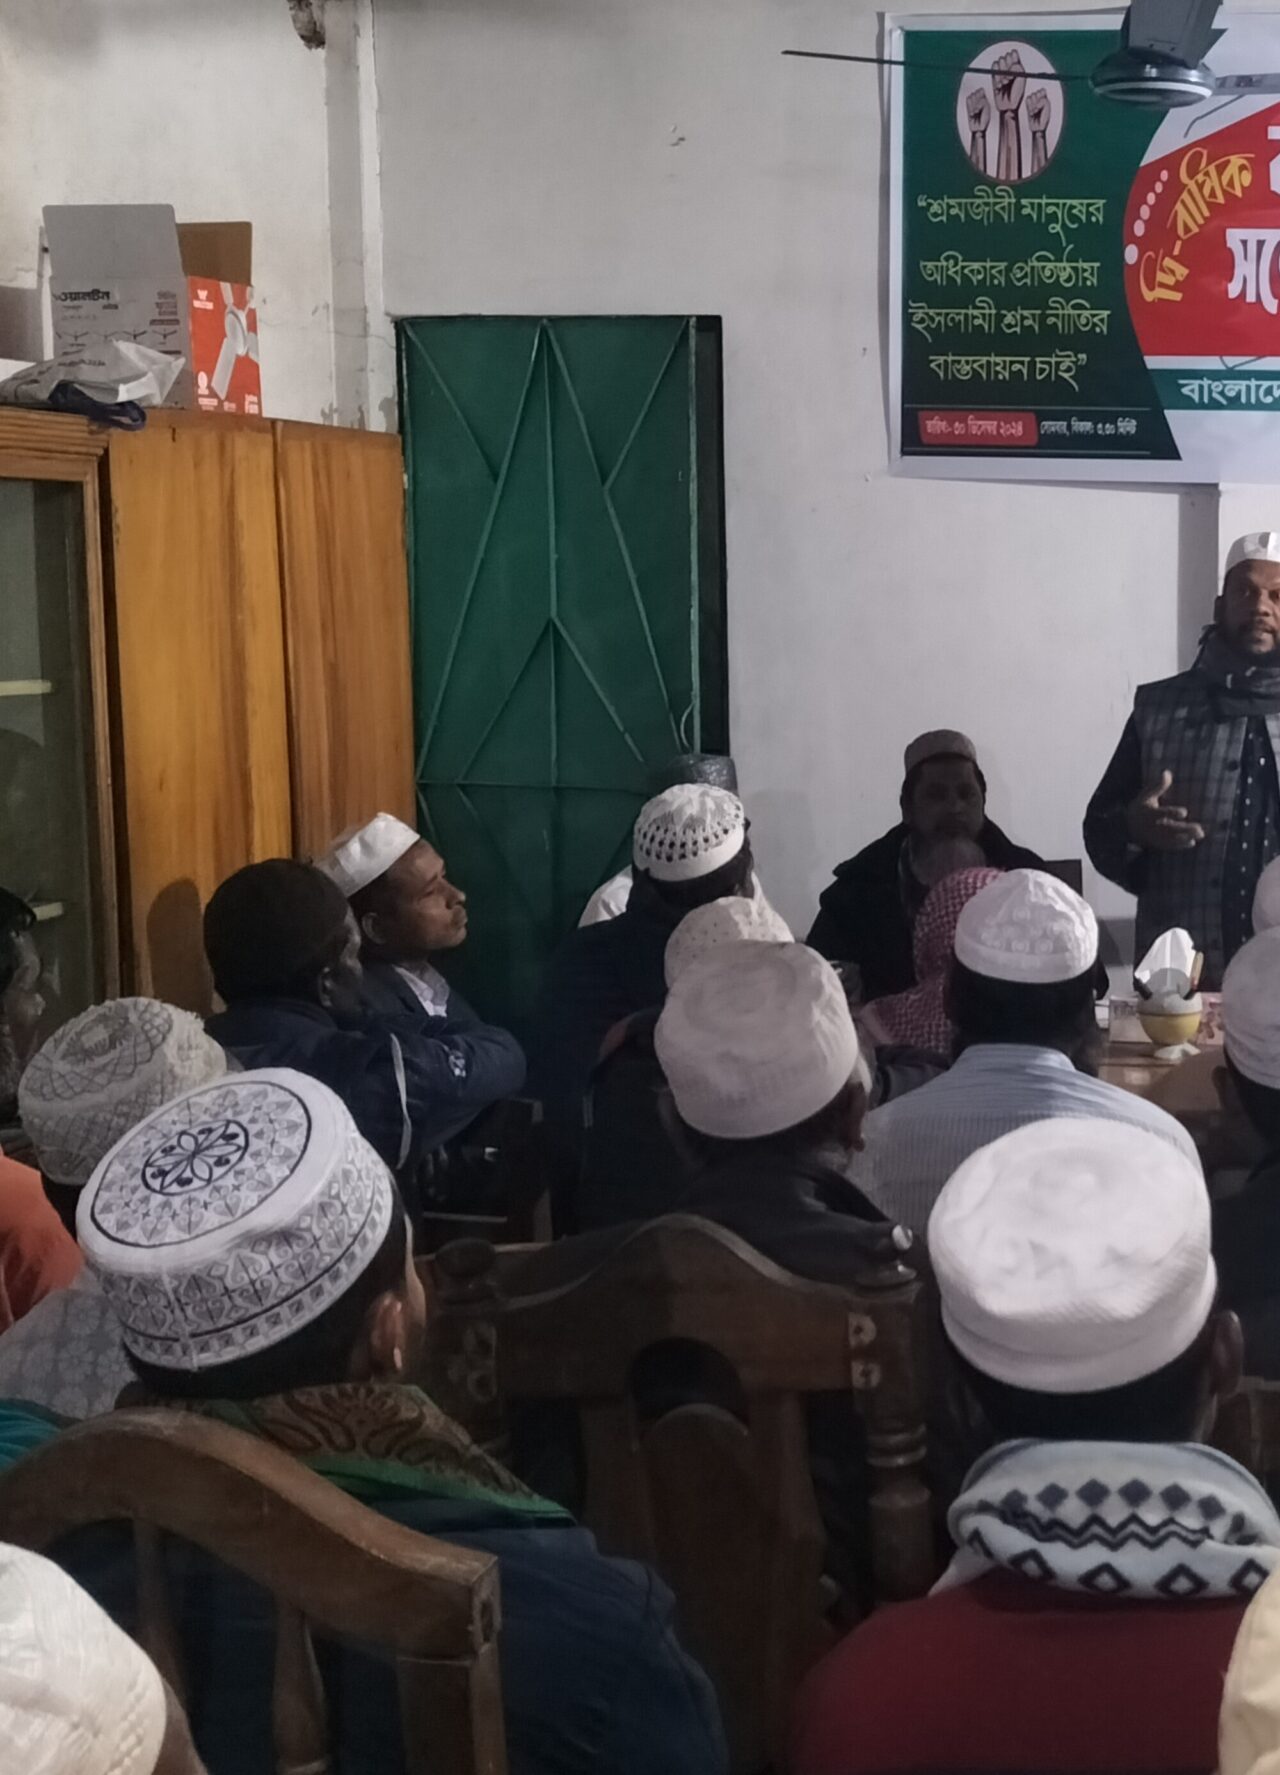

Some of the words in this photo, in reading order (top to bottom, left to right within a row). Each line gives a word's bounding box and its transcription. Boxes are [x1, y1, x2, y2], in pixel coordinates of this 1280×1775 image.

[1020, 194, 1107, 247] মানুষের
[919, 251, 1008, 288] অধিকার
[1009, 244, 1101, 288] প্রতিষ্ঠায়
[908, 296, 997, 343] ইসলামী
[1000, 305, 1042, 334] শ্রম
[1046, 297, 1111, 335] নীতির
[928, 352, 1031, 381] বাস্তবায়ন
